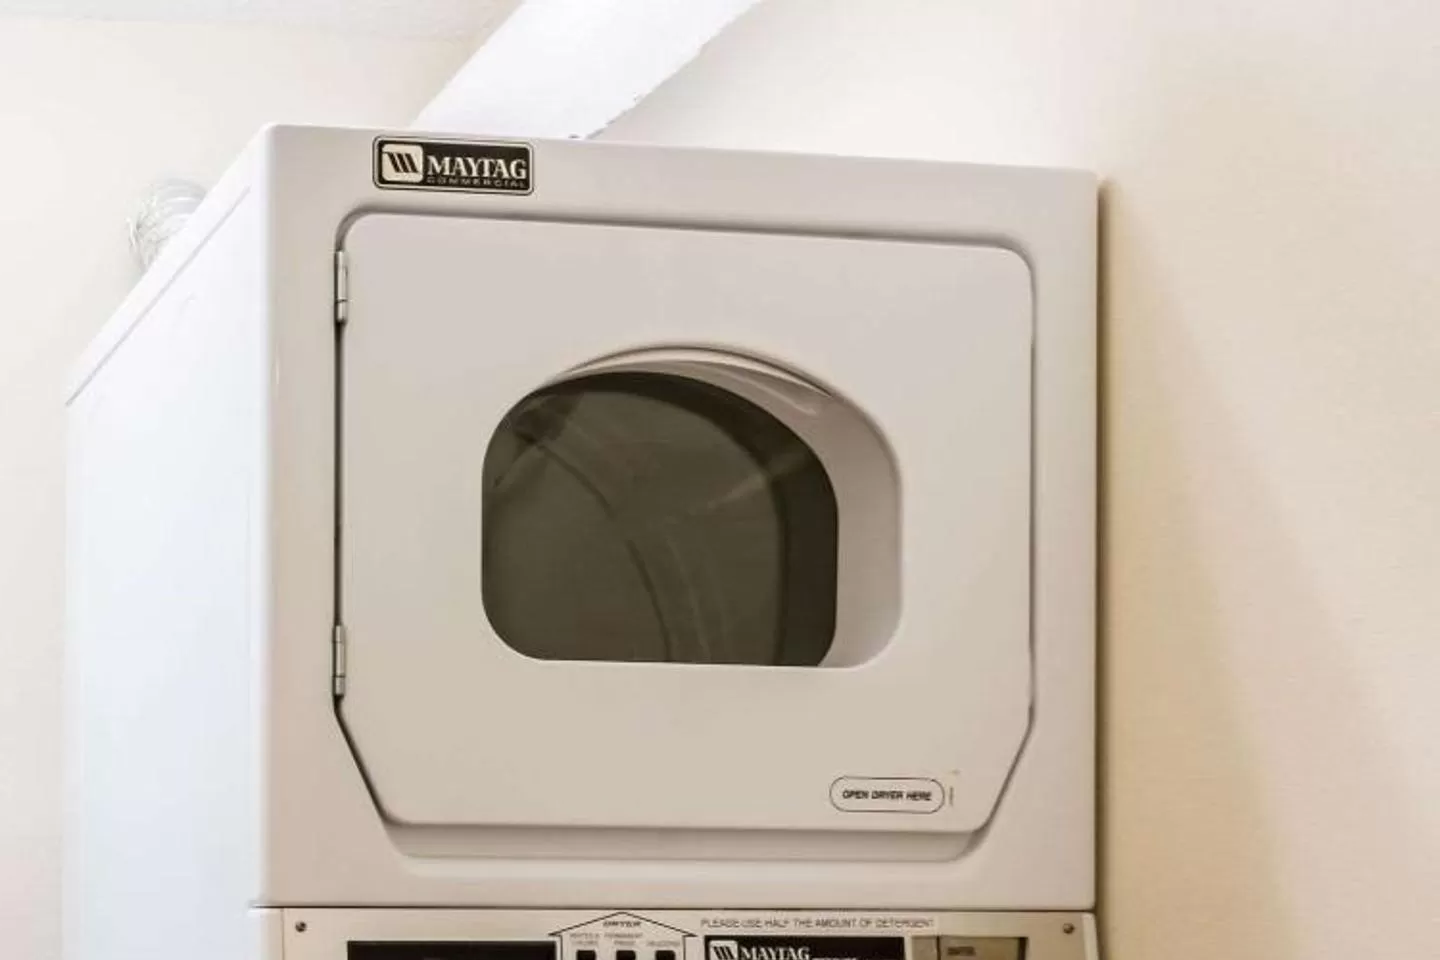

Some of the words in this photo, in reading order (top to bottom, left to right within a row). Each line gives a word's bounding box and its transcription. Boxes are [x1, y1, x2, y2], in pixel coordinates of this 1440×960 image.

[427, 155, 527, 179] MAYTAG
[427, 176, 526, 188] COMMERCIAL
[842, 790, 869, 800] OPEN
[871, 790, 904, 800] DRYER
[906, 790, 932, 801] HERE
[701, 918, 740, 929] PLEASE
[793, 918, 814, 929] THE
[815, 918, 857, 929] AMOUNT
[860, 918, 873, 929] OF
[876, 918, 934, 929] DETERGENT
[740, 946, 810, 960] MAYTAG
